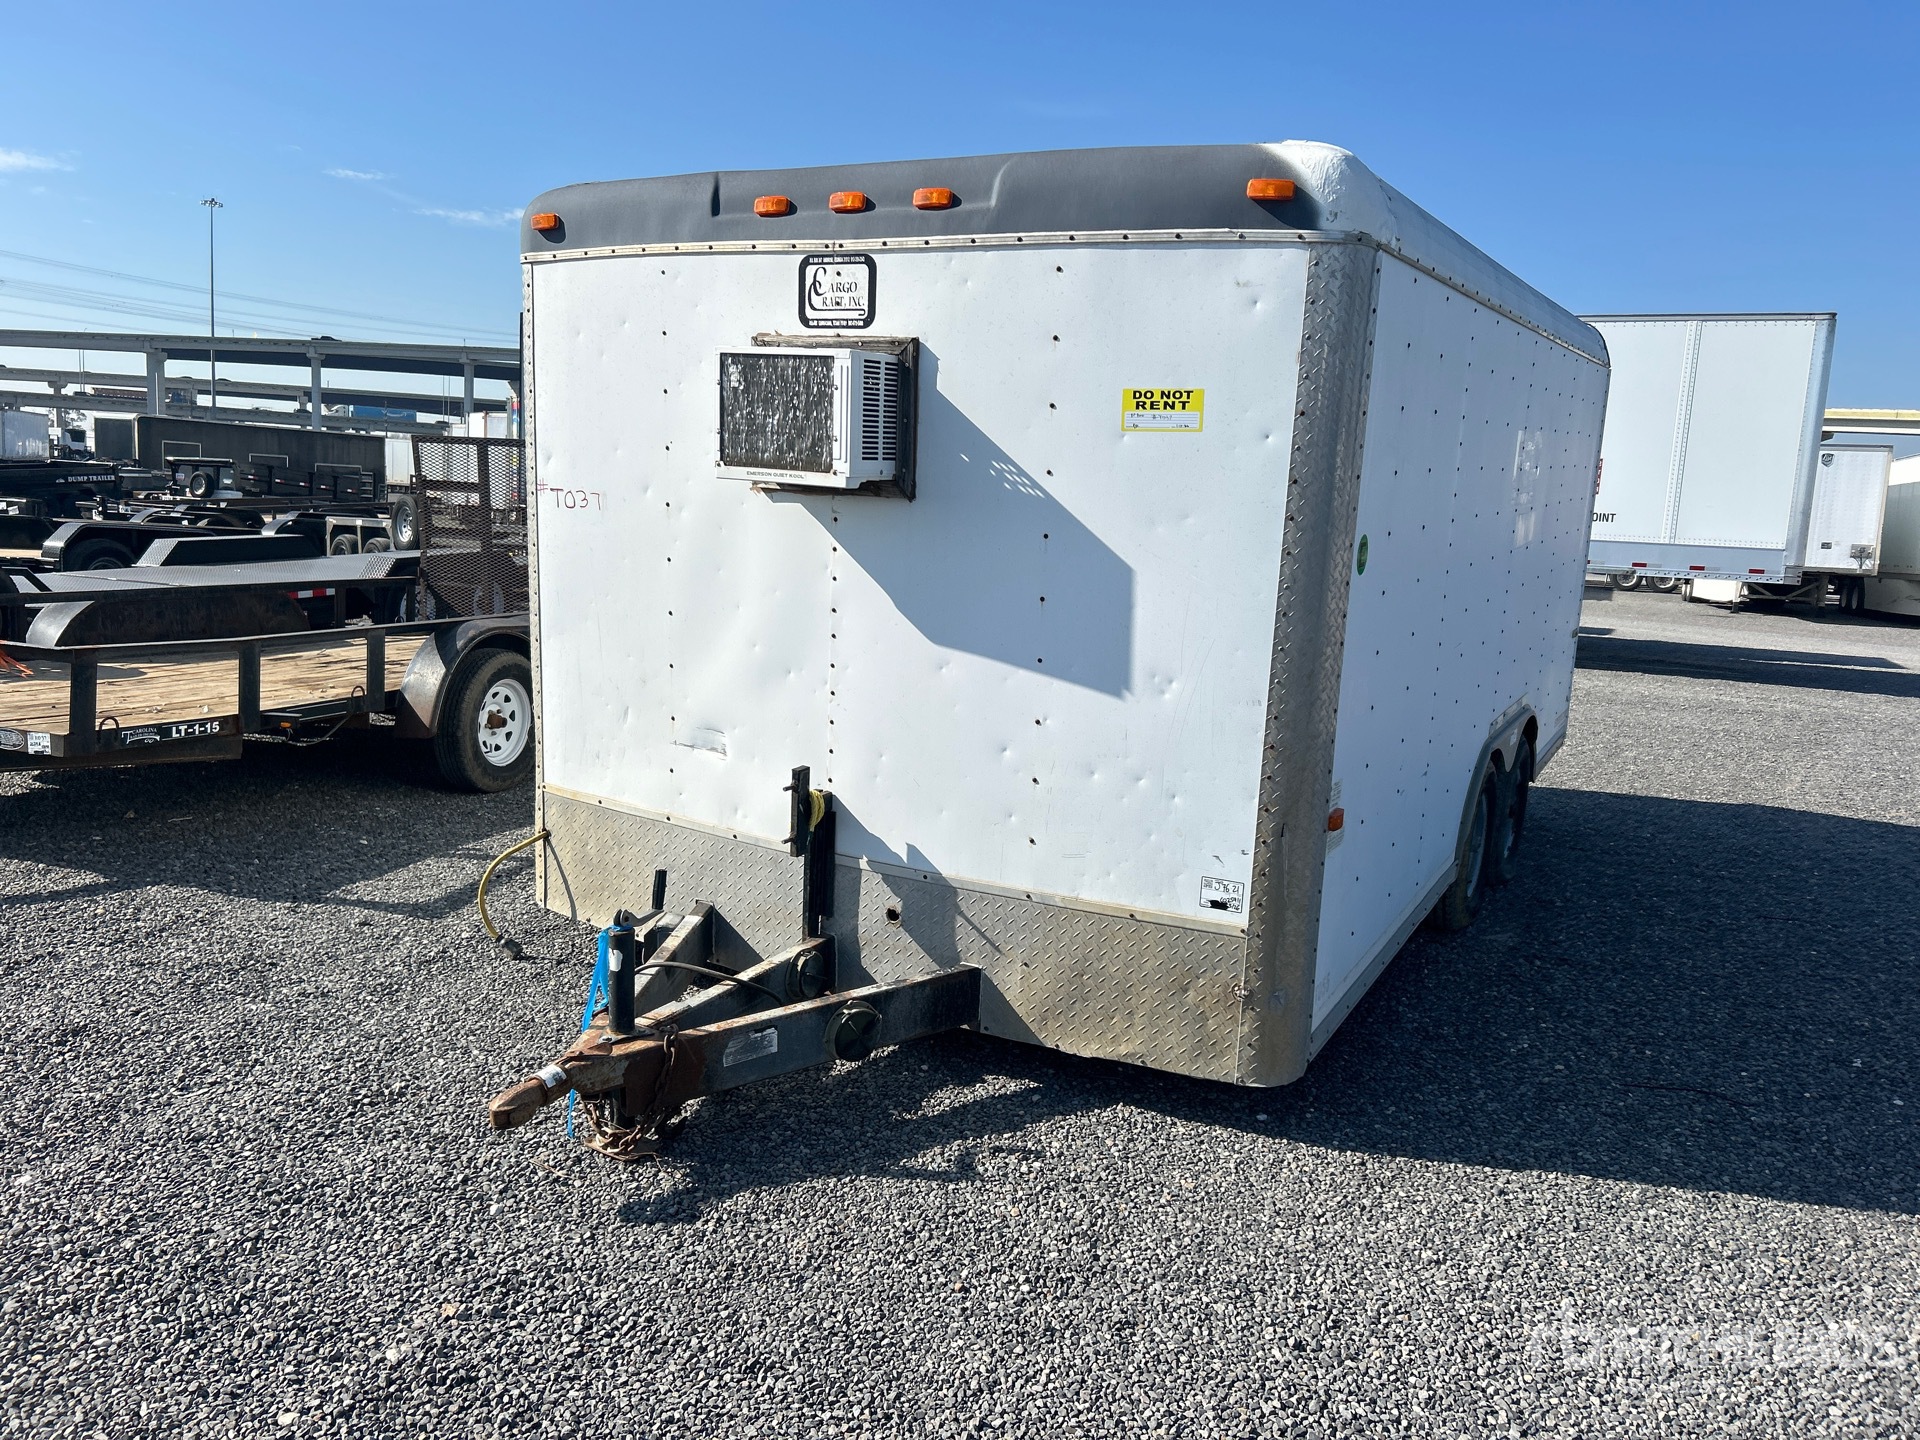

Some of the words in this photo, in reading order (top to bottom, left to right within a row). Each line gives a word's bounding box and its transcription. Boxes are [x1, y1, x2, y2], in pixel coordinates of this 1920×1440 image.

[813, 267, 858, 296] CARGO
[848, 296, 865, 307] INC.
[1132, 390, 1155, 400] DO
[1160, 390, 1194, 400] NOT
[1135, 400, 1190, 411] RENT
[172, 722, 220, 738] LT-1-15
